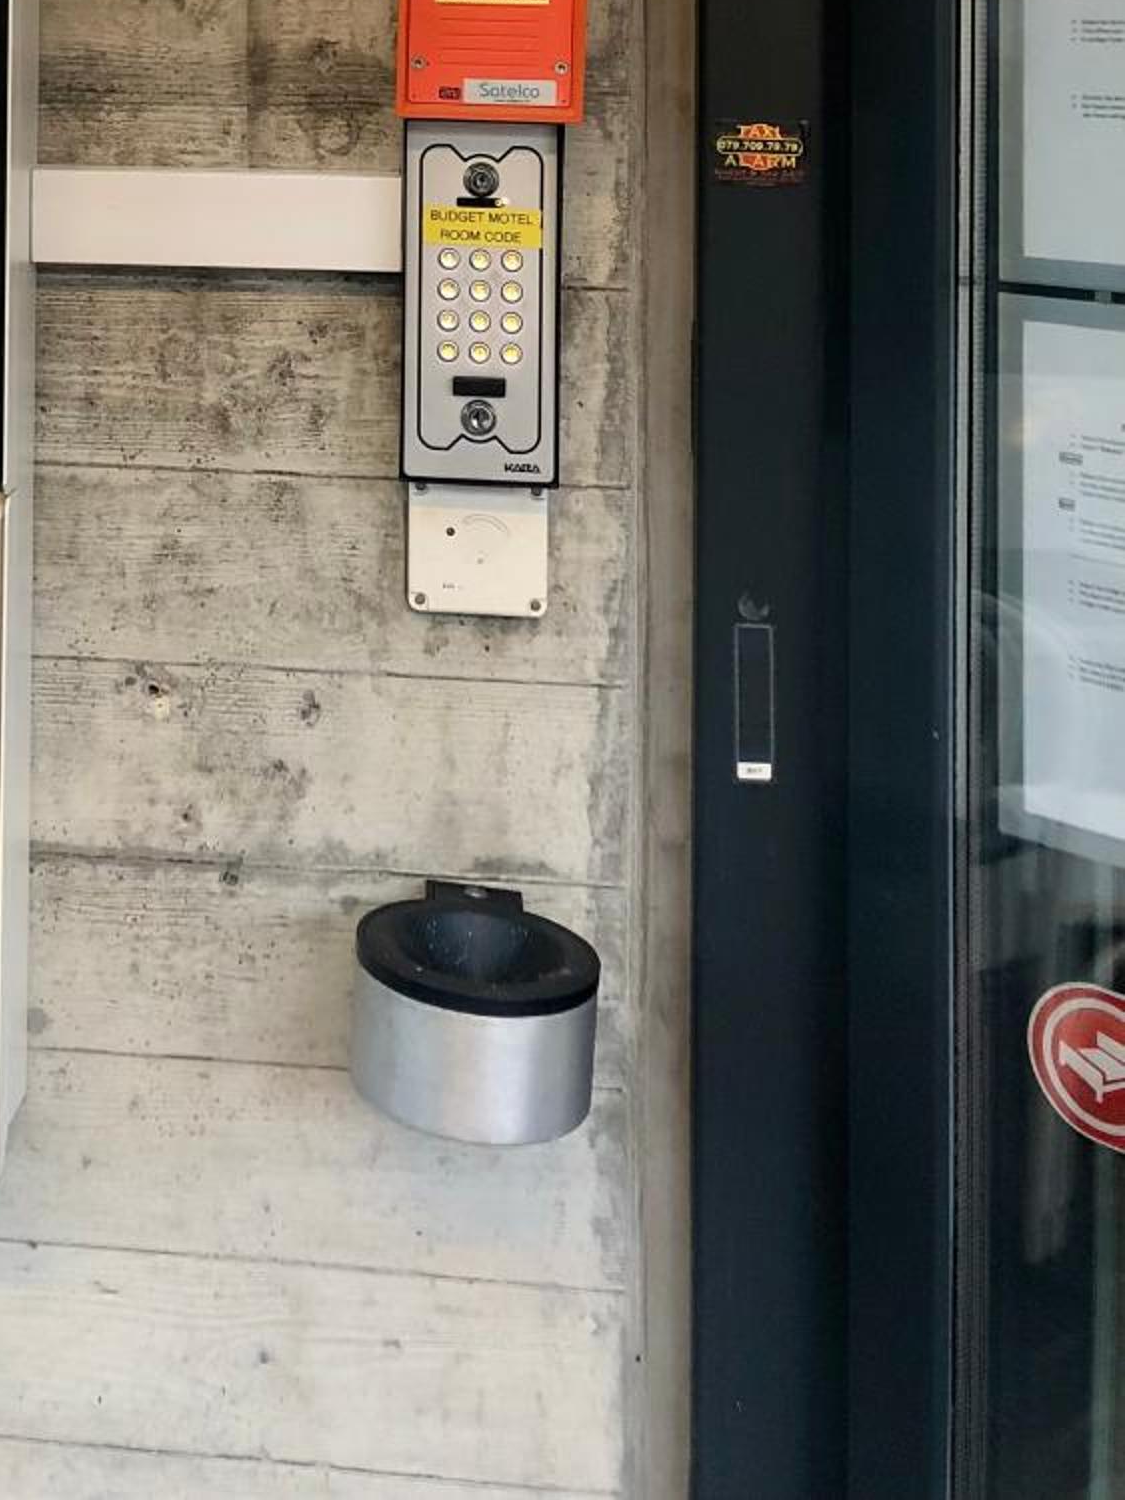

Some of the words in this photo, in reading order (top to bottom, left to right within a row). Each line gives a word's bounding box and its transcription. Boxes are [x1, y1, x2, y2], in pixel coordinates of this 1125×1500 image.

[478, 82, 540, 99] Satelco
[430, 209, 485, 222] BUDGET
[488, 212, 534, 225] MOTEL
[440, 228, 481, 241] ROOM
[484, 231, 522, 243] CODE
